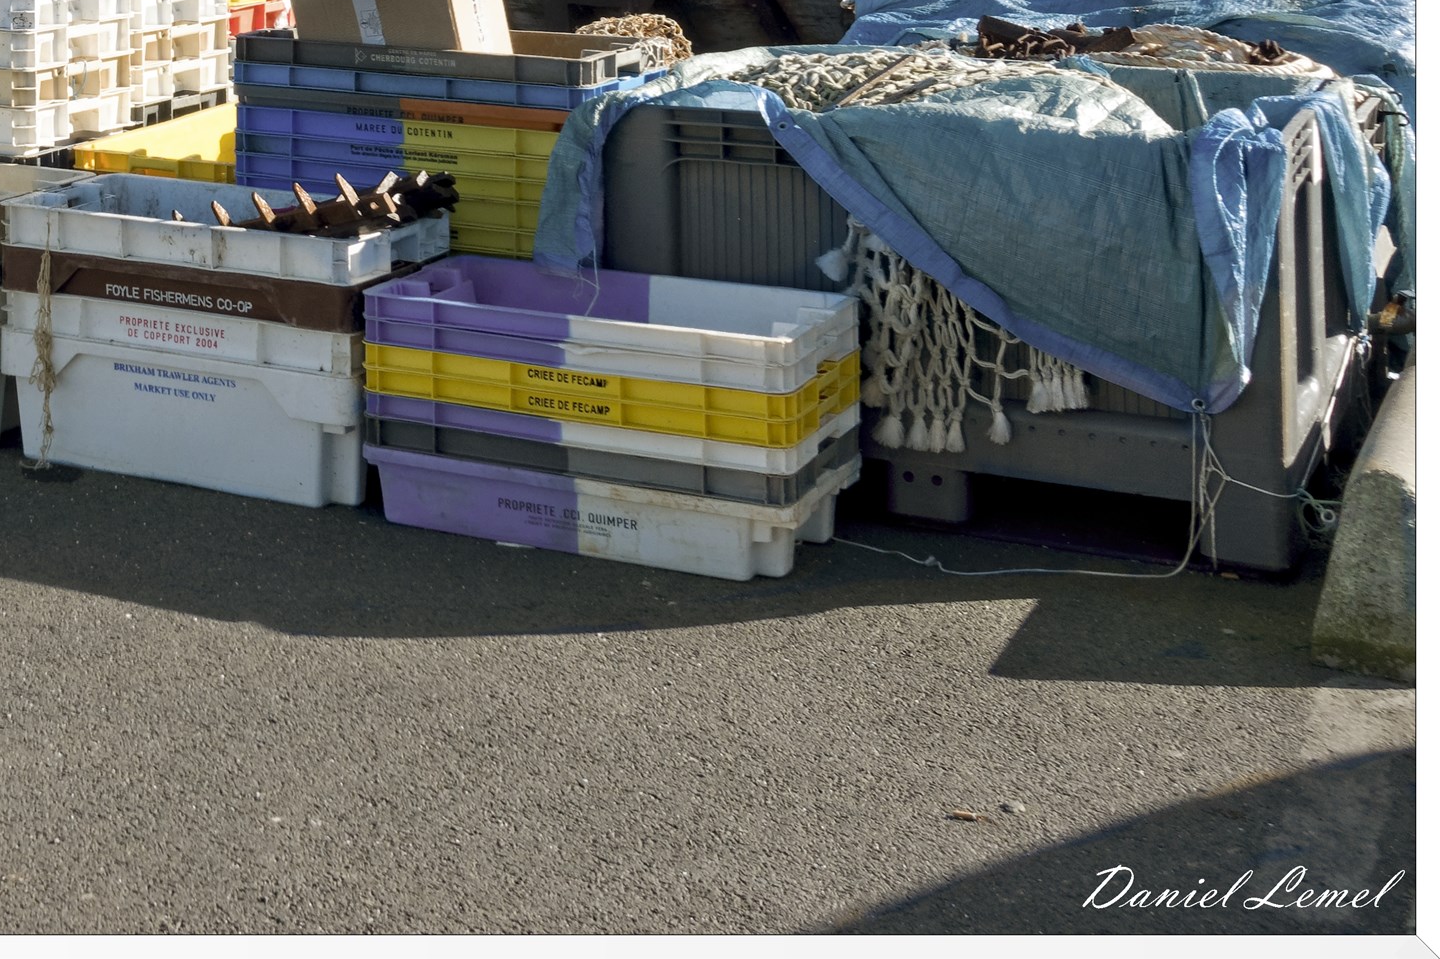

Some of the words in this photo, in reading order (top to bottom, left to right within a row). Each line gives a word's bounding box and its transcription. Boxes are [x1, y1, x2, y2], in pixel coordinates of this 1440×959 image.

[370, 54, 416, 65] CHERBOURG
[418, 57, 457, 68] COTENTIN
[421, 112, 465, 124] QUIMPER
[356, 122, 386, 134] MAREE
[390, 125, 403, 135] DU
[407, 127, 453, 139] COTENTIN
[105, 283, 140, 300] FOYLE
[143, 288, 213, 309] FISHERMENS
[216, 297, 253, 313] CO-OP
[119, 315, 170, 331] PROPRIETE
[175, 323, 225, 339] EXCLUSIVE
[127, 328, 138, 338] DE
[144, 330, 190, 345] COPEPORT
[195, 337, 218, 349] 2004
[113, 362, 156, 377] BRIXHAM
[156, 368, 200, 383] TRAWLER
[201, 376, 237, 388] AGENTS
[527, 368, 555, 382] CRIEE
[557, 372, 569, 384] DE
[571, 374, 608, 388] FECAMP
[134, 382, 171, 396] MARKET
[174, 389, 190, 399] USE
[191, 392, 216, 403] ONLY
[528, 396, 555, 409] CRIEE
[558, 400, 570, 411] DE
[572, 402, 610, 416] FECAMP
[498, 497, 555, 517] PROPRIETE
[588, 512, 637, 531] QUIMPER
